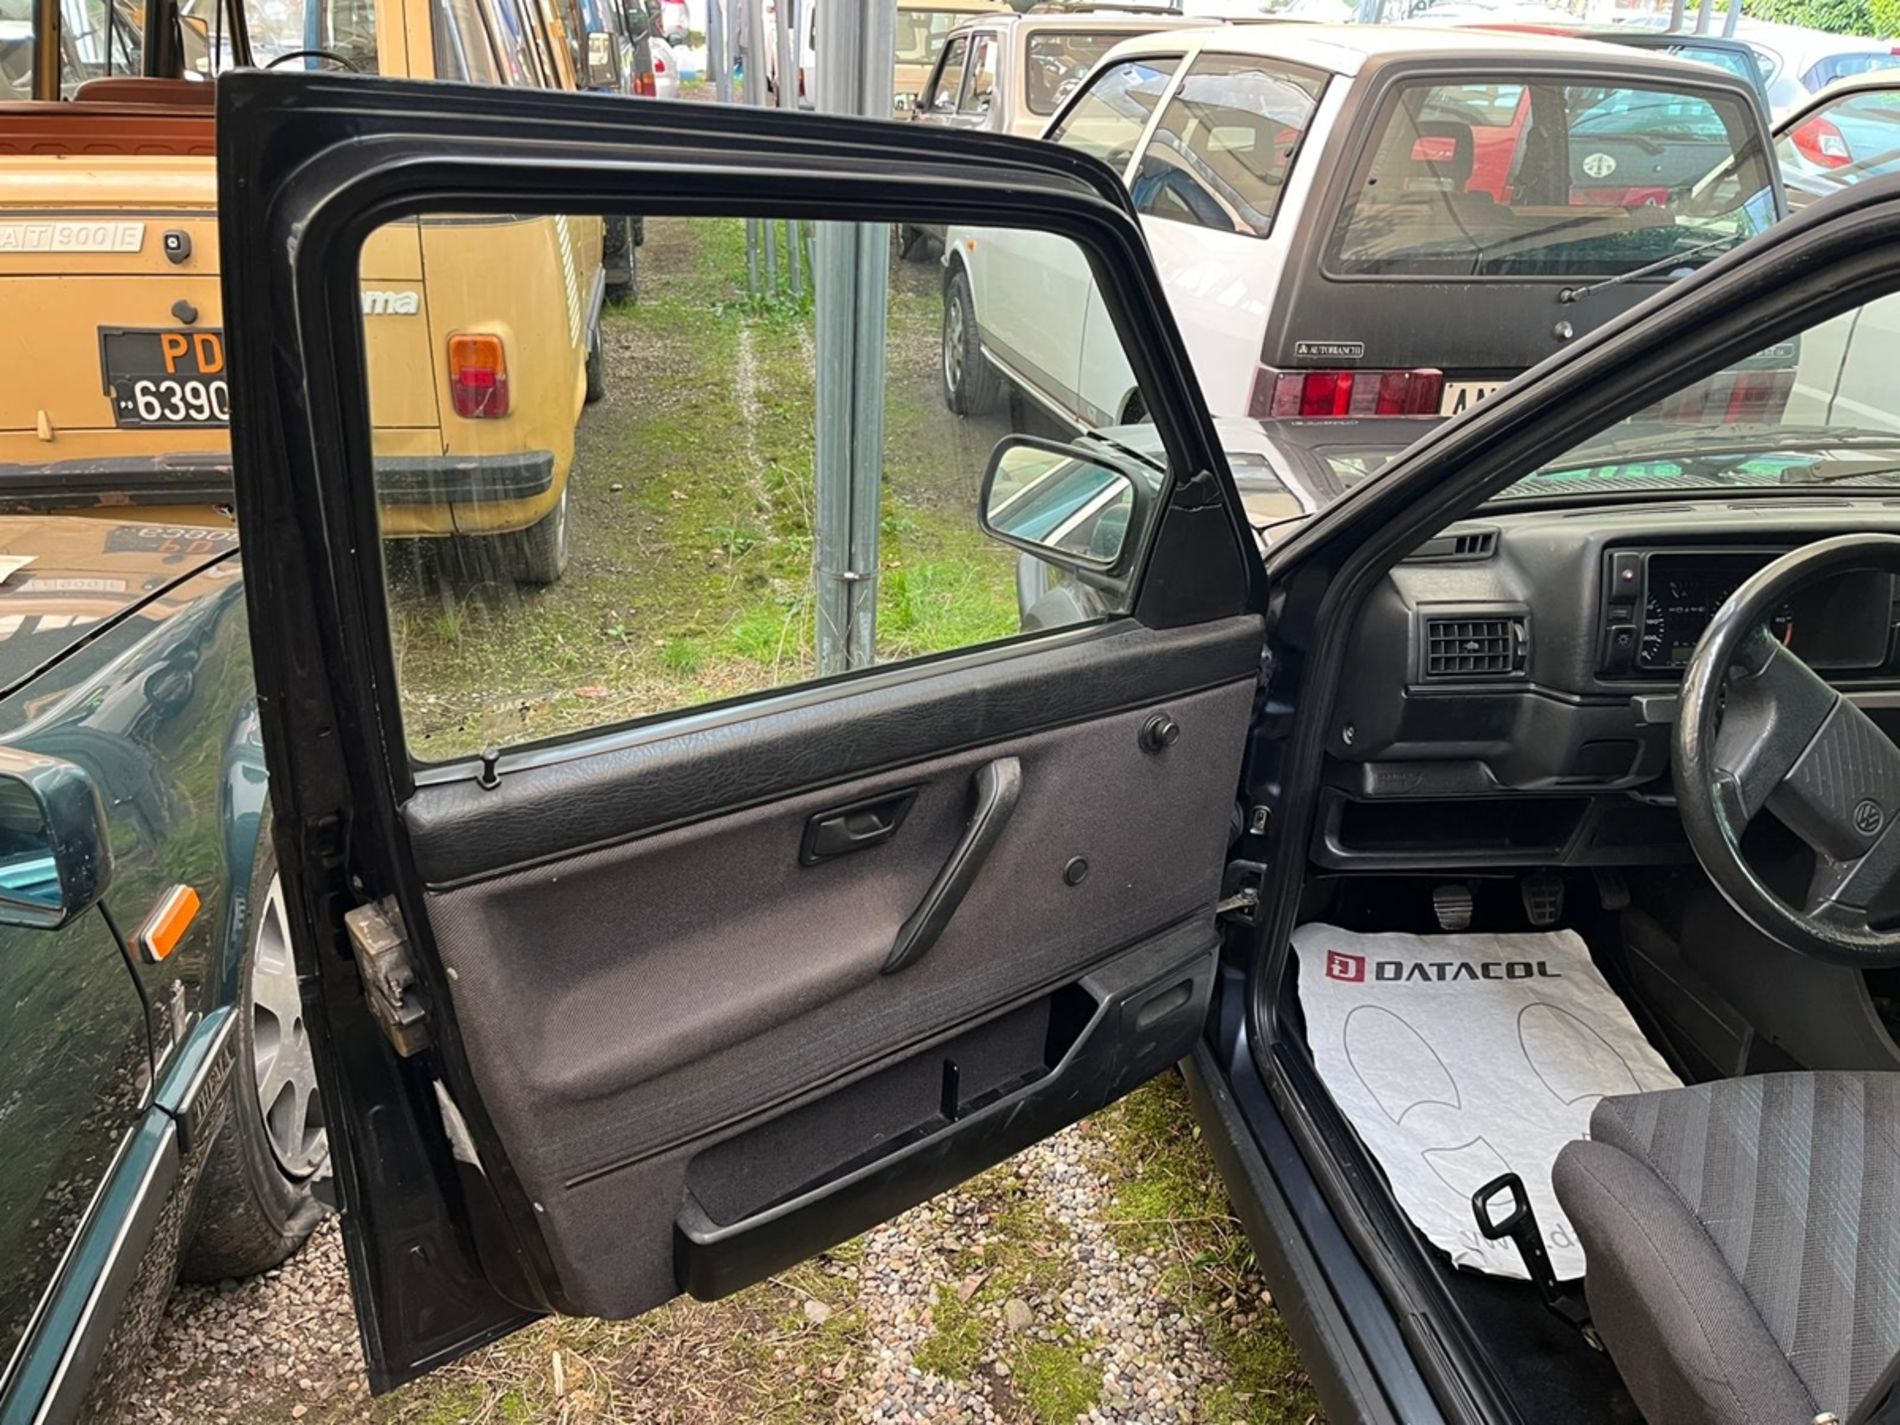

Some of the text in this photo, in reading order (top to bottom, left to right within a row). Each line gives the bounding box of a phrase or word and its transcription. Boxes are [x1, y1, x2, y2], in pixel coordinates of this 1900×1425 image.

[57, 226, 109, 246] 900
[119, 226, 138, 246] E
[361, 291, 419, 314] ma
[160, 332, 224, 374] PD
[134, 380, 230, 421] 6390
[1375, 960, 1563, 982] DATACOL
